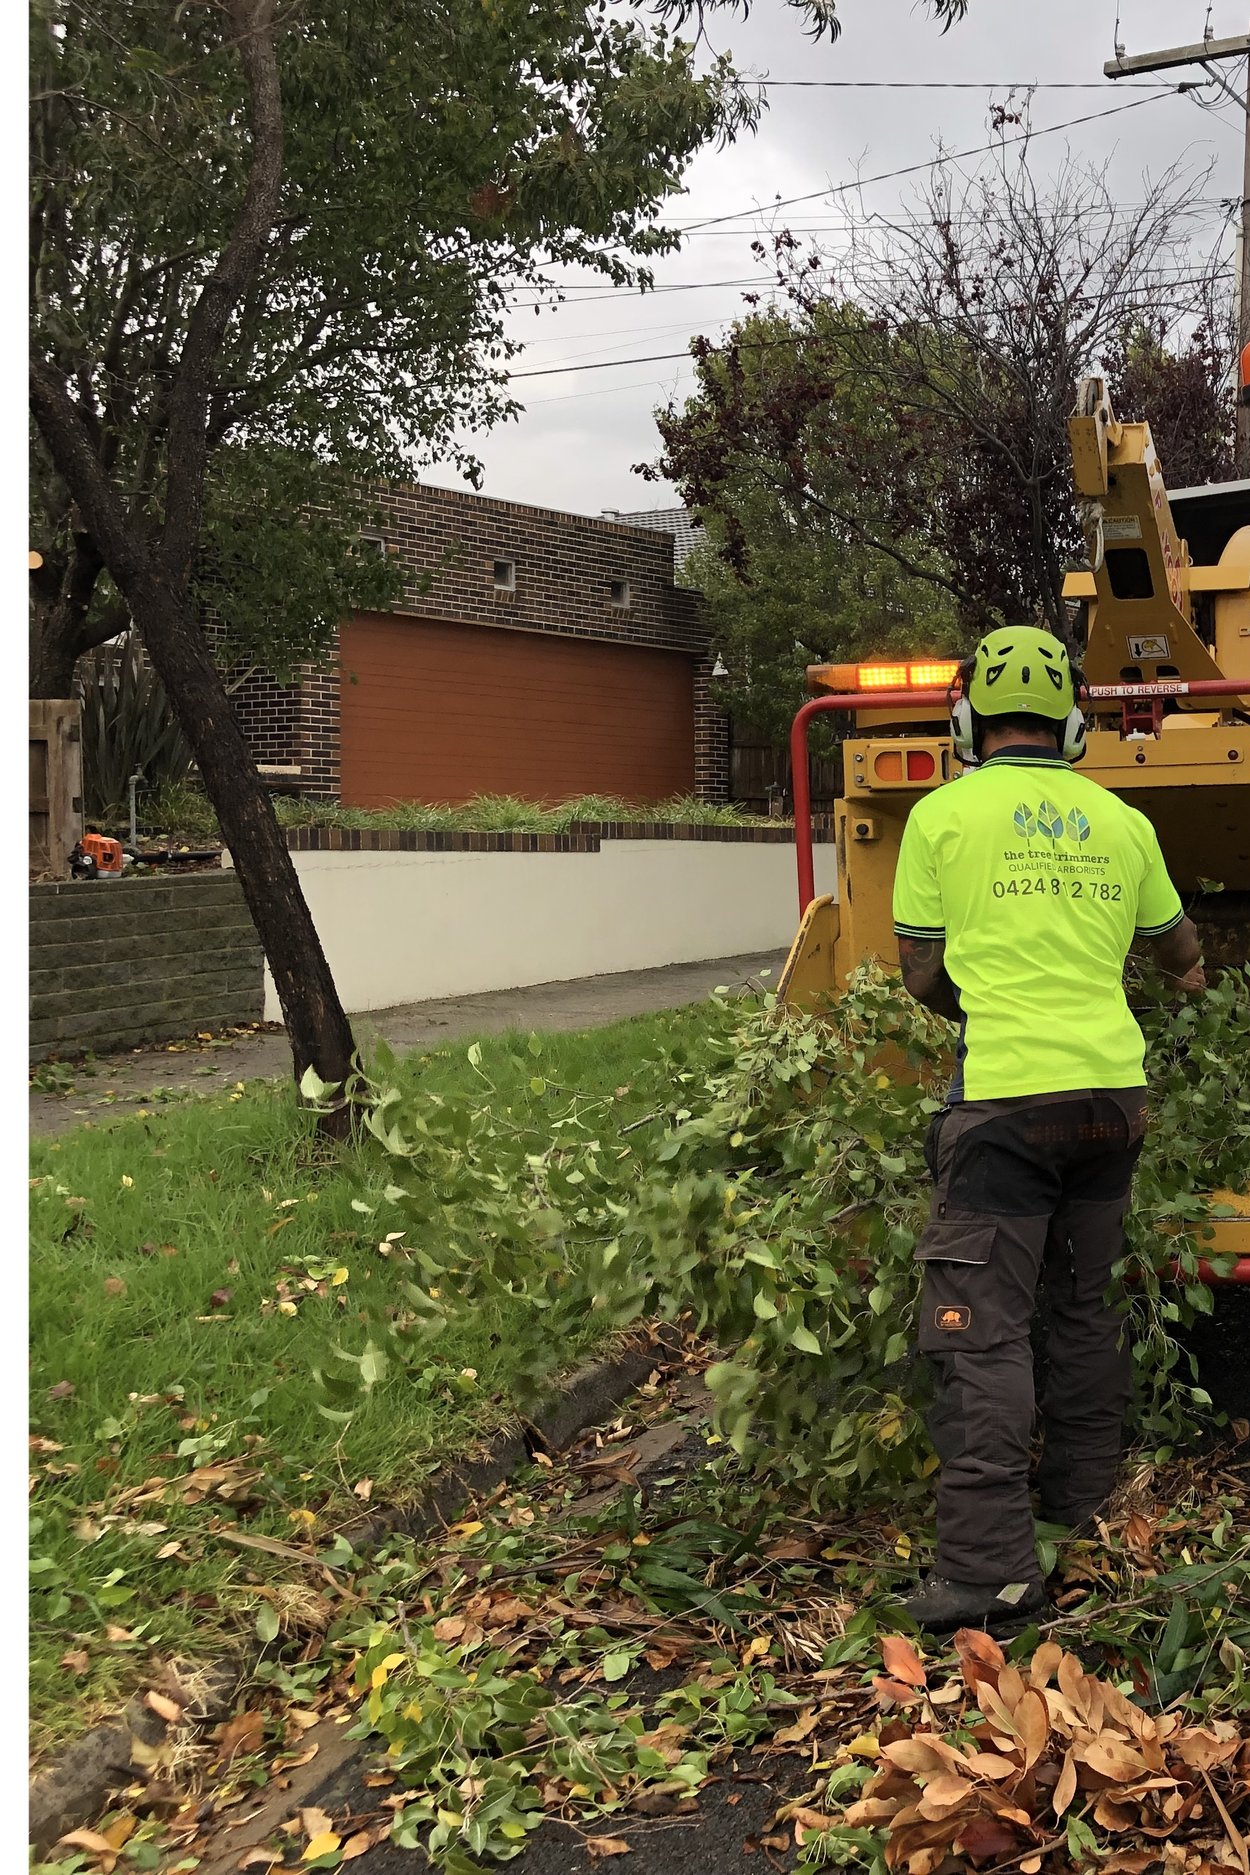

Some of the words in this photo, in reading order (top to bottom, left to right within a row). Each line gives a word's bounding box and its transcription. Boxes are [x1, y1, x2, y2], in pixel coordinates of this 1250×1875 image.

[1091, 687, 1117, 696] PUSH
[1122, 686, 1134, 695] TO
[1137, 684, 1183, 694] REVERSE
[1004, 850, 1025, 861] the
[1028, 850, 1052, 860] tree
[1053, 851, 1110, 864] trimmers
[1057, 866, 1106, 876] ARBORISTS
[992, 878, 1047, 899] 0424
[1089, 882, 1122, 901] 782
